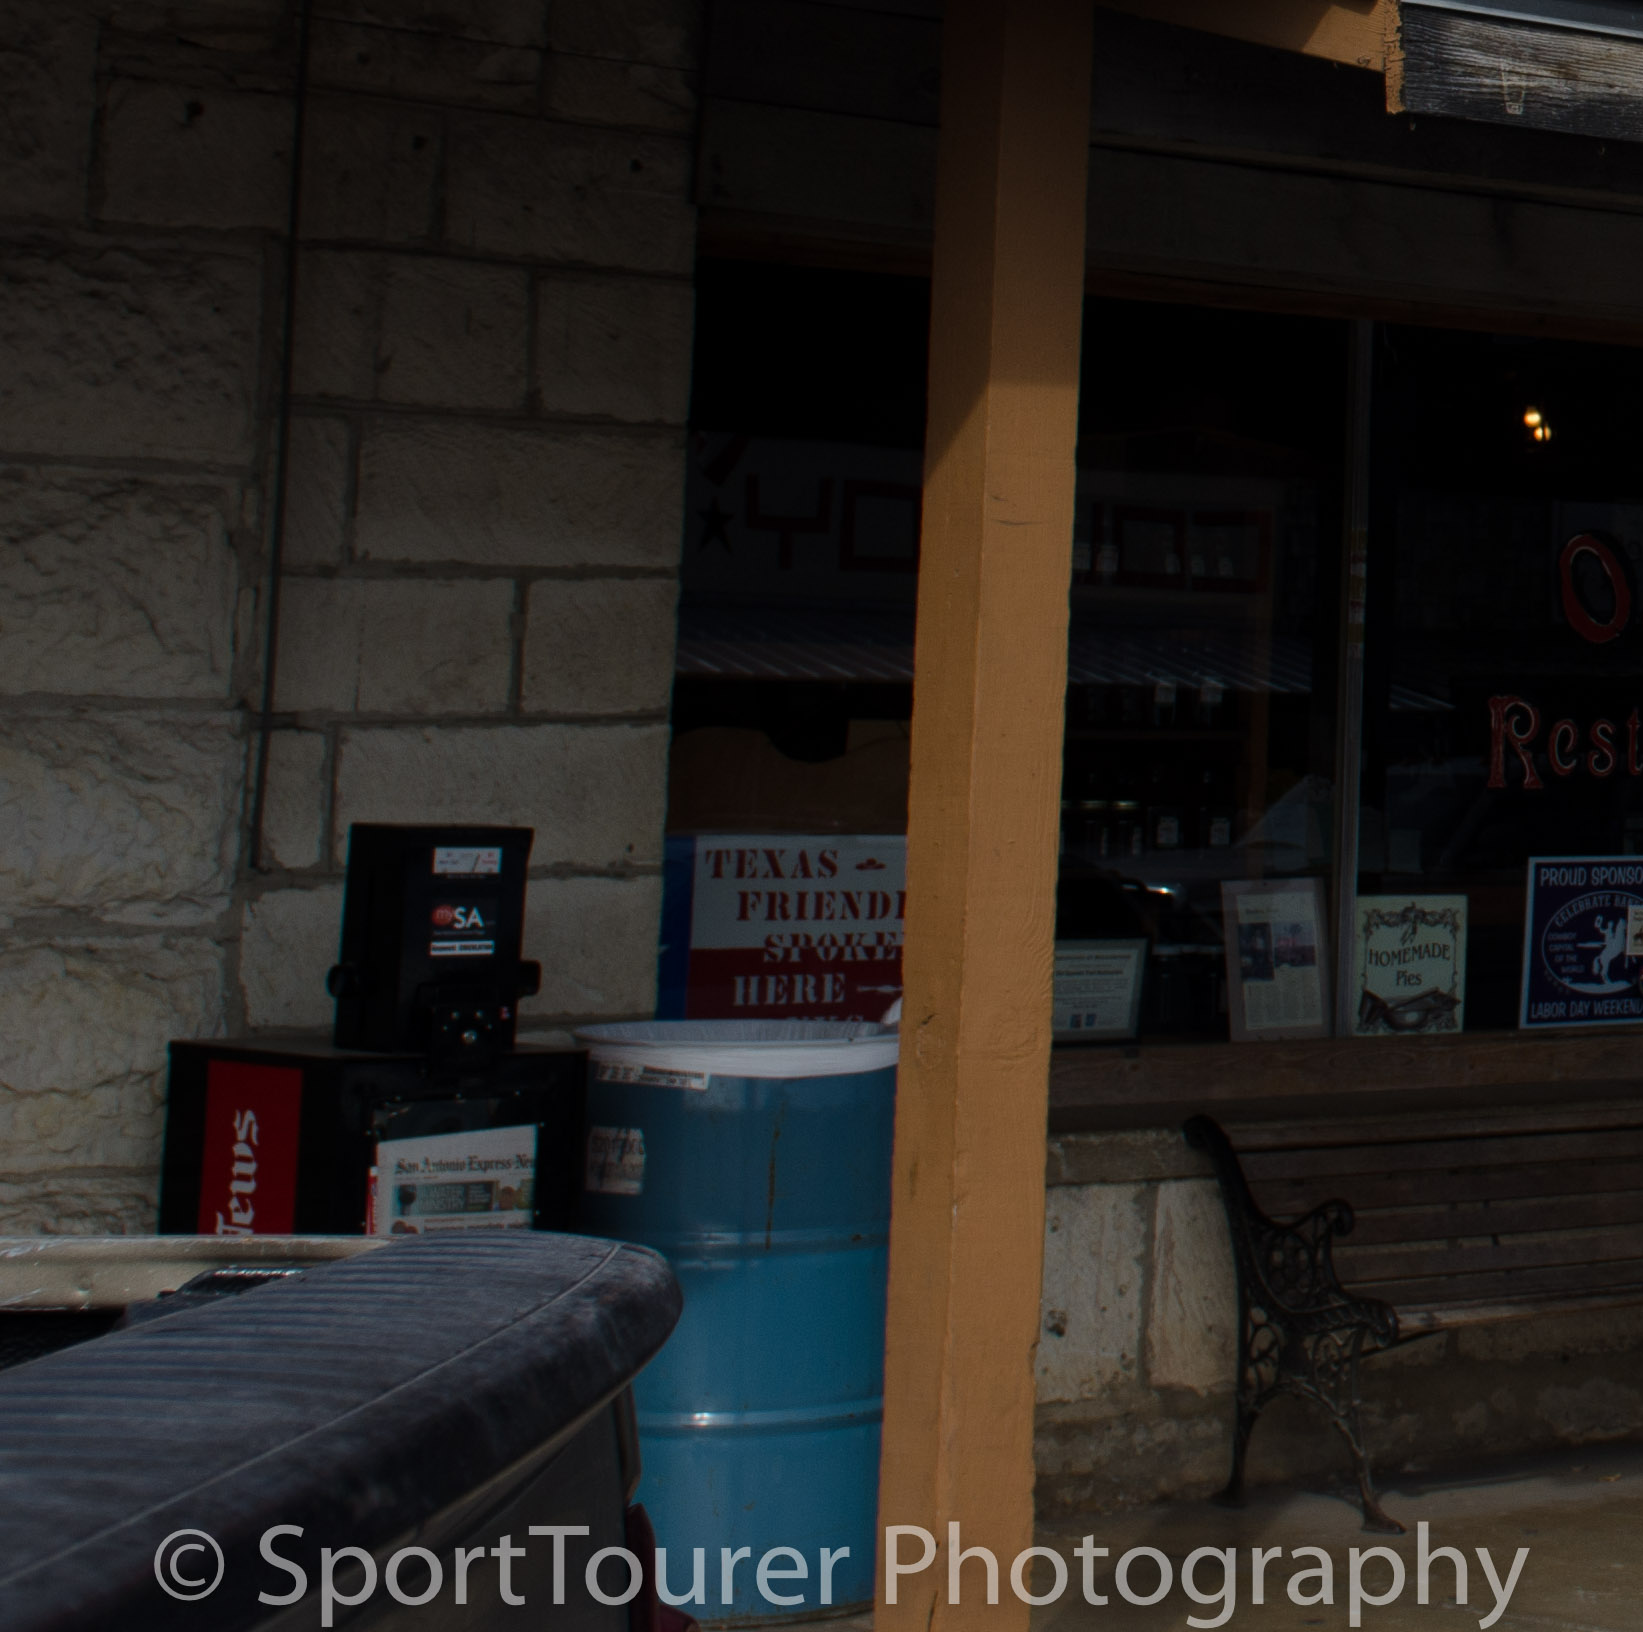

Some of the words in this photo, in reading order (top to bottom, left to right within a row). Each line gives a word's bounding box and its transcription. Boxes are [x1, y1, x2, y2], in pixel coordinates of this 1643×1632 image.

[705, 848, 840, 880] TEXAS
[1540, 866, 1587, 887] PROUD
[1368, 942, 1450, 967] HOMEMADE
[732, 972, 847, 1007] HERE
[1396, 970, 1422, 987] Pies
[1531, 1000, 1567, 1018] LABOR
[1569, 999, 1592, 1017] DAY
[1592, 998, 1643, 1016] WEEKEND
